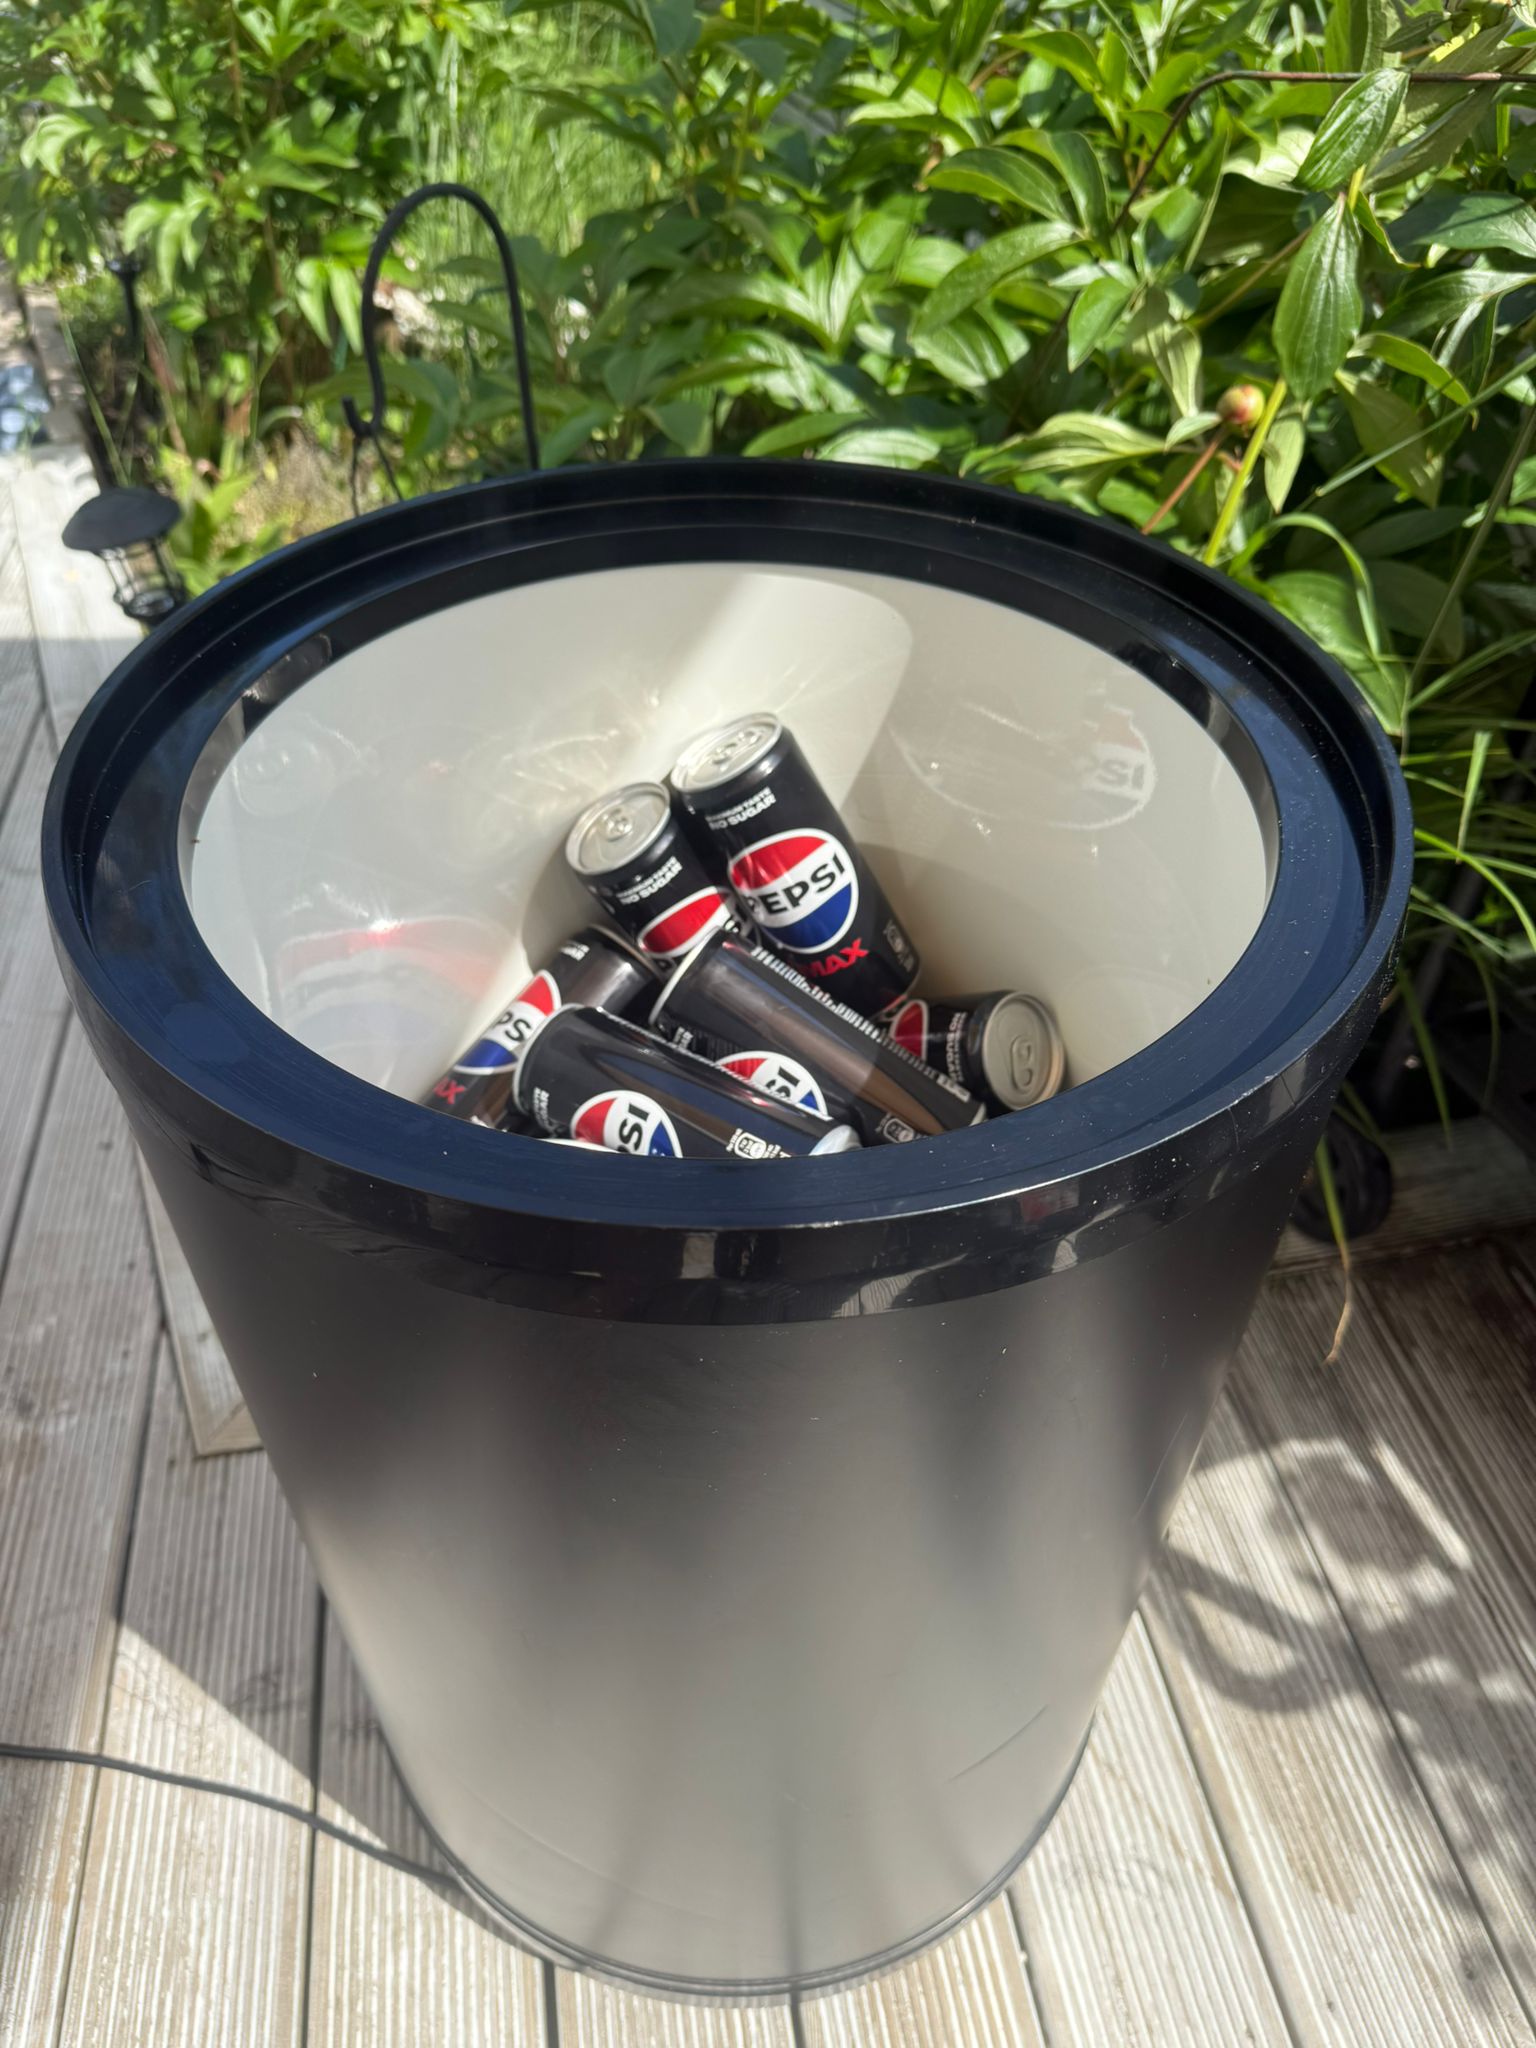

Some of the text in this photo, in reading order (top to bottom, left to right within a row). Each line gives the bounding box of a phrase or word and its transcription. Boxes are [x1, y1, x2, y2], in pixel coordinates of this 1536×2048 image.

[708, 793, 777, 831] NO SUGAR
[639, 862, 683, 899] SUGAR
[803, 938, 869, 978] MAX
